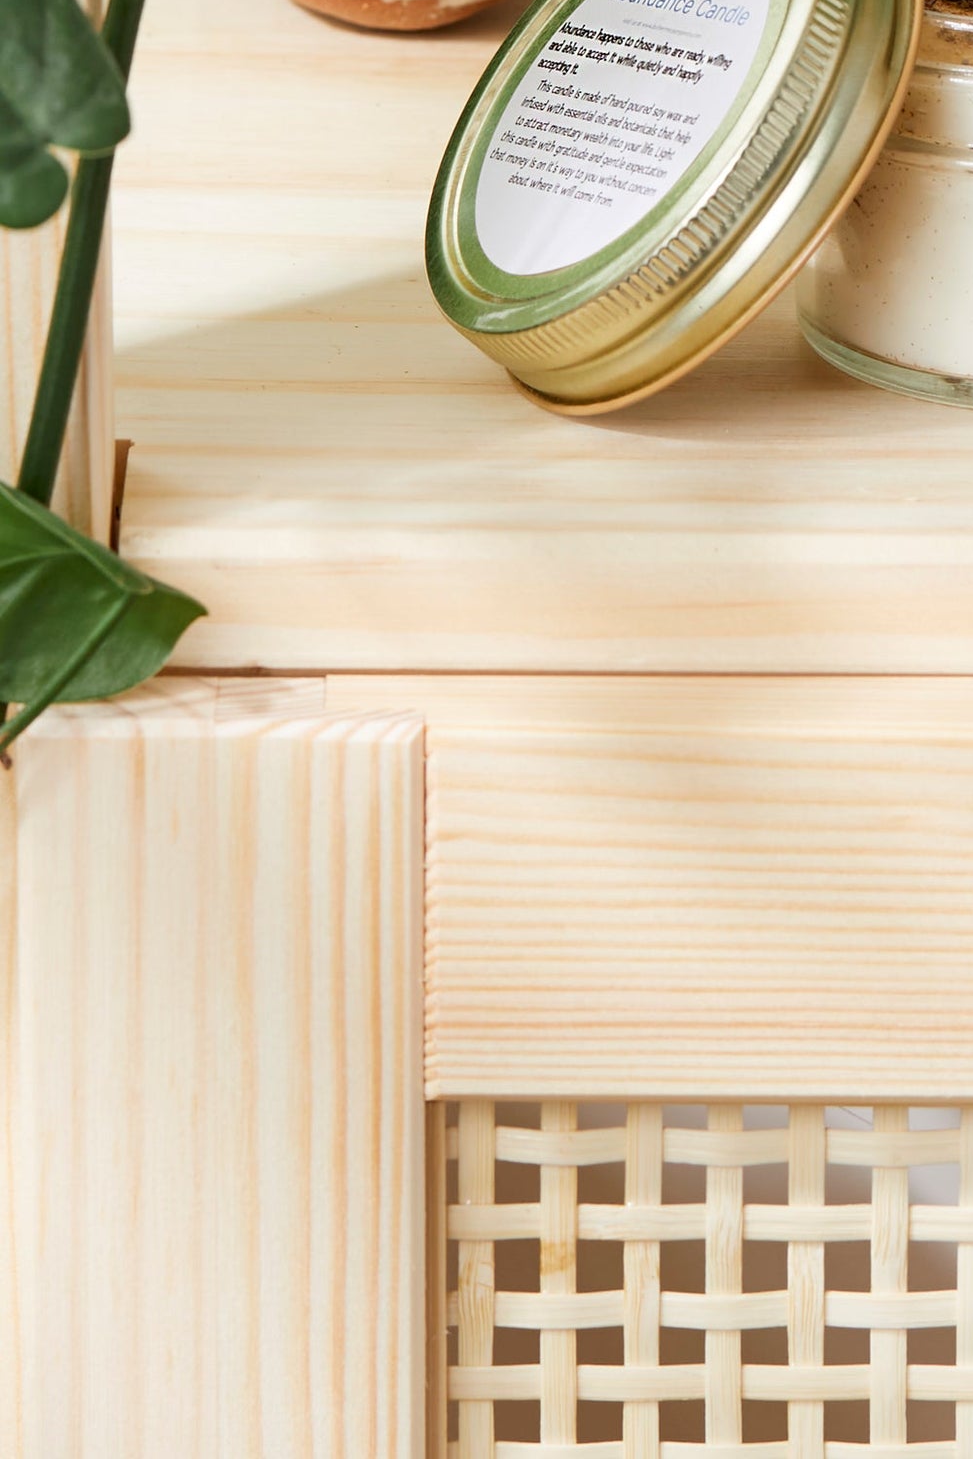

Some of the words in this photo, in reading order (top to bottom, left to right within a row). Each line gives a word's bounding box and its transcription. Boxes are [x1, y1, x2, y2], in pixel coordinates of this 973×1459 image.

[538, 58, 571, 75] accepting
[549, 40, 565, 51] and
[562, 41, 577, 55] able
[577, 46, 586, 56] to
[586, 49, 609, 63] accept
[609, 52, 617, 62] it
[617, 53, 637, 67] while
[637, 60, 663, 76] quietly
[662, 64, 679, 76] and
[676, 65, 704, 84] happily
[559, 22, 596, 39] Abundance
[596, 28, 625, 45] happens
[625, 37, 634, 46] to
[634, 37, 655, 51] those
[655, 42, 672, 55] who
[671, 48, 684, 57] are
[707, 54, 732, 71] willing
[521, 97, 549, 111] infused
[547, 103, 564, 114] with
[564, 108, 597, 122] essential
[595, 113, 608, 125] oils
[608, 117, 624, 128] and
[622, 118, 657, 135] botanicals
[657, 126, 674, 140] that
[674, 130, 691, 146] help
[537, 80, 552, 93] This
[552, 85, 574, 97] candle
[574, 88, 582, 99] is
[581, 91, 601, 103] made
[610, 94, 630, 109] hand
[625, 101, 655, 114] poured
[653, 107, 667, 120] soy
[667, 111, 682, 122] wax
[683, 114, 700, 125] and
[501, 130, 515, 143] this
[515, 136, 537, 148] candle
[537, 141, 556, 152] with
[553, 145, 589, 159] gratitude
[588, 152, 605, 163] and
[600, 155, 626, 168] gentle
[626, 162, 668, 178] expectation
[515, 116, 524, 125] to
[524, 118, 549, 131] attract
[548, 124, 583, 142] monetary
[583, 132, 608, 145] wealth
[608, 134, 624, 148] into
[621, 140, 641, 152] your
[490, 148, 506, 161] that
[505, 153, 528, 169] money
[529, 157, 537, 168] is
[536, 161, 546, 170] on
[559, 168, 575, 179] way
[575, 168, 584, 178] to
[581, 172, 597, 183] you
[599, 175, 628, 190] without
[508, 172, 530, 186] about
[529, 177, 553, 192] where
[574, 190, 595, 202] come
